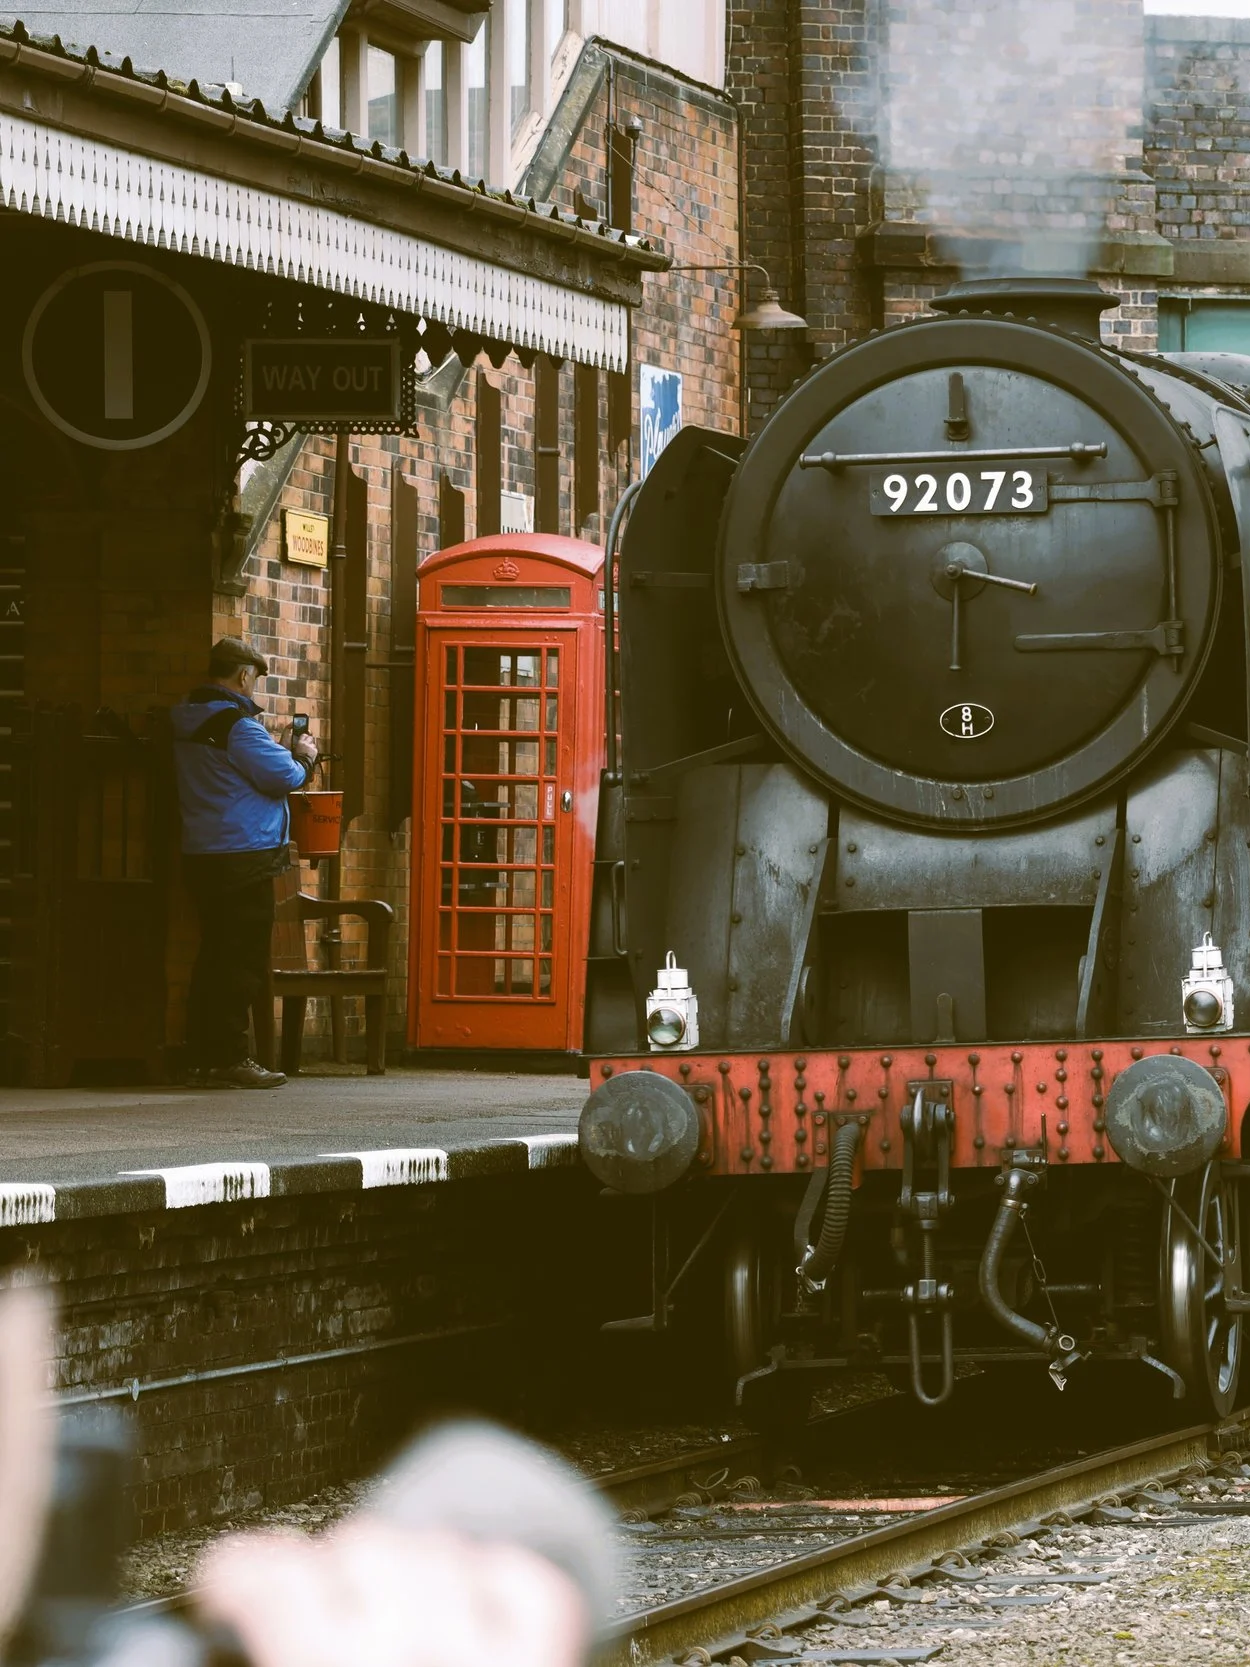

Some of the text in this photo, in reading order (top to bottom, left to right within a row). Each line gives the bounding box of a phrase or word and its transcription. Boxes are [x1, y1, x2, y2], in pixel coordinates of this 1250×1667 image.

[261, 364, 384, 392] WAY OUT
[883, 470, 1034, 513] 92073
[292, 535, 324, 557] WOODBINES
[312, 814, 341, 824] SERVIC
